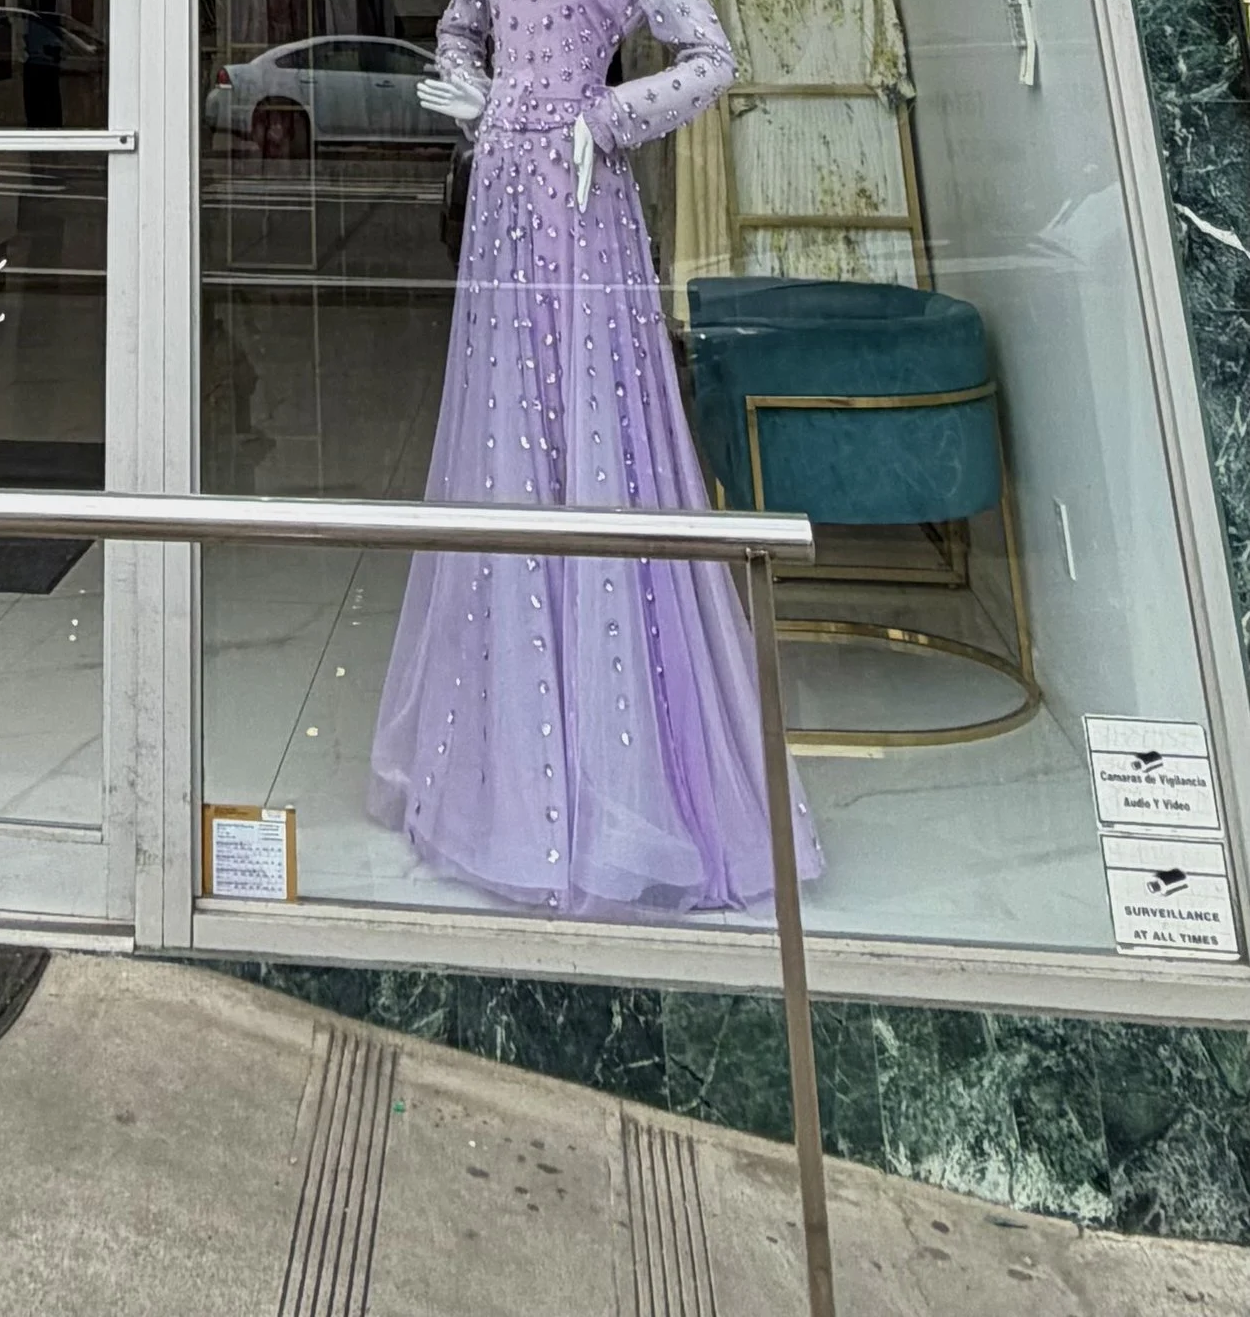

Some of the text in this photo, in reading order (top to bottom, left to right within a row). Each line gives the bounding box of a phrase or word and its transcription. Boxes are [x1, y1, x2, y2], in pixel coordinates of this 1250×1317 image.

[1124, 796, 1191, 812] Audio Y Video
[1124, 905, 1221, 923] SURVEILLANCE
[1133, 929, 1220, 946] AT ALL TIMES
